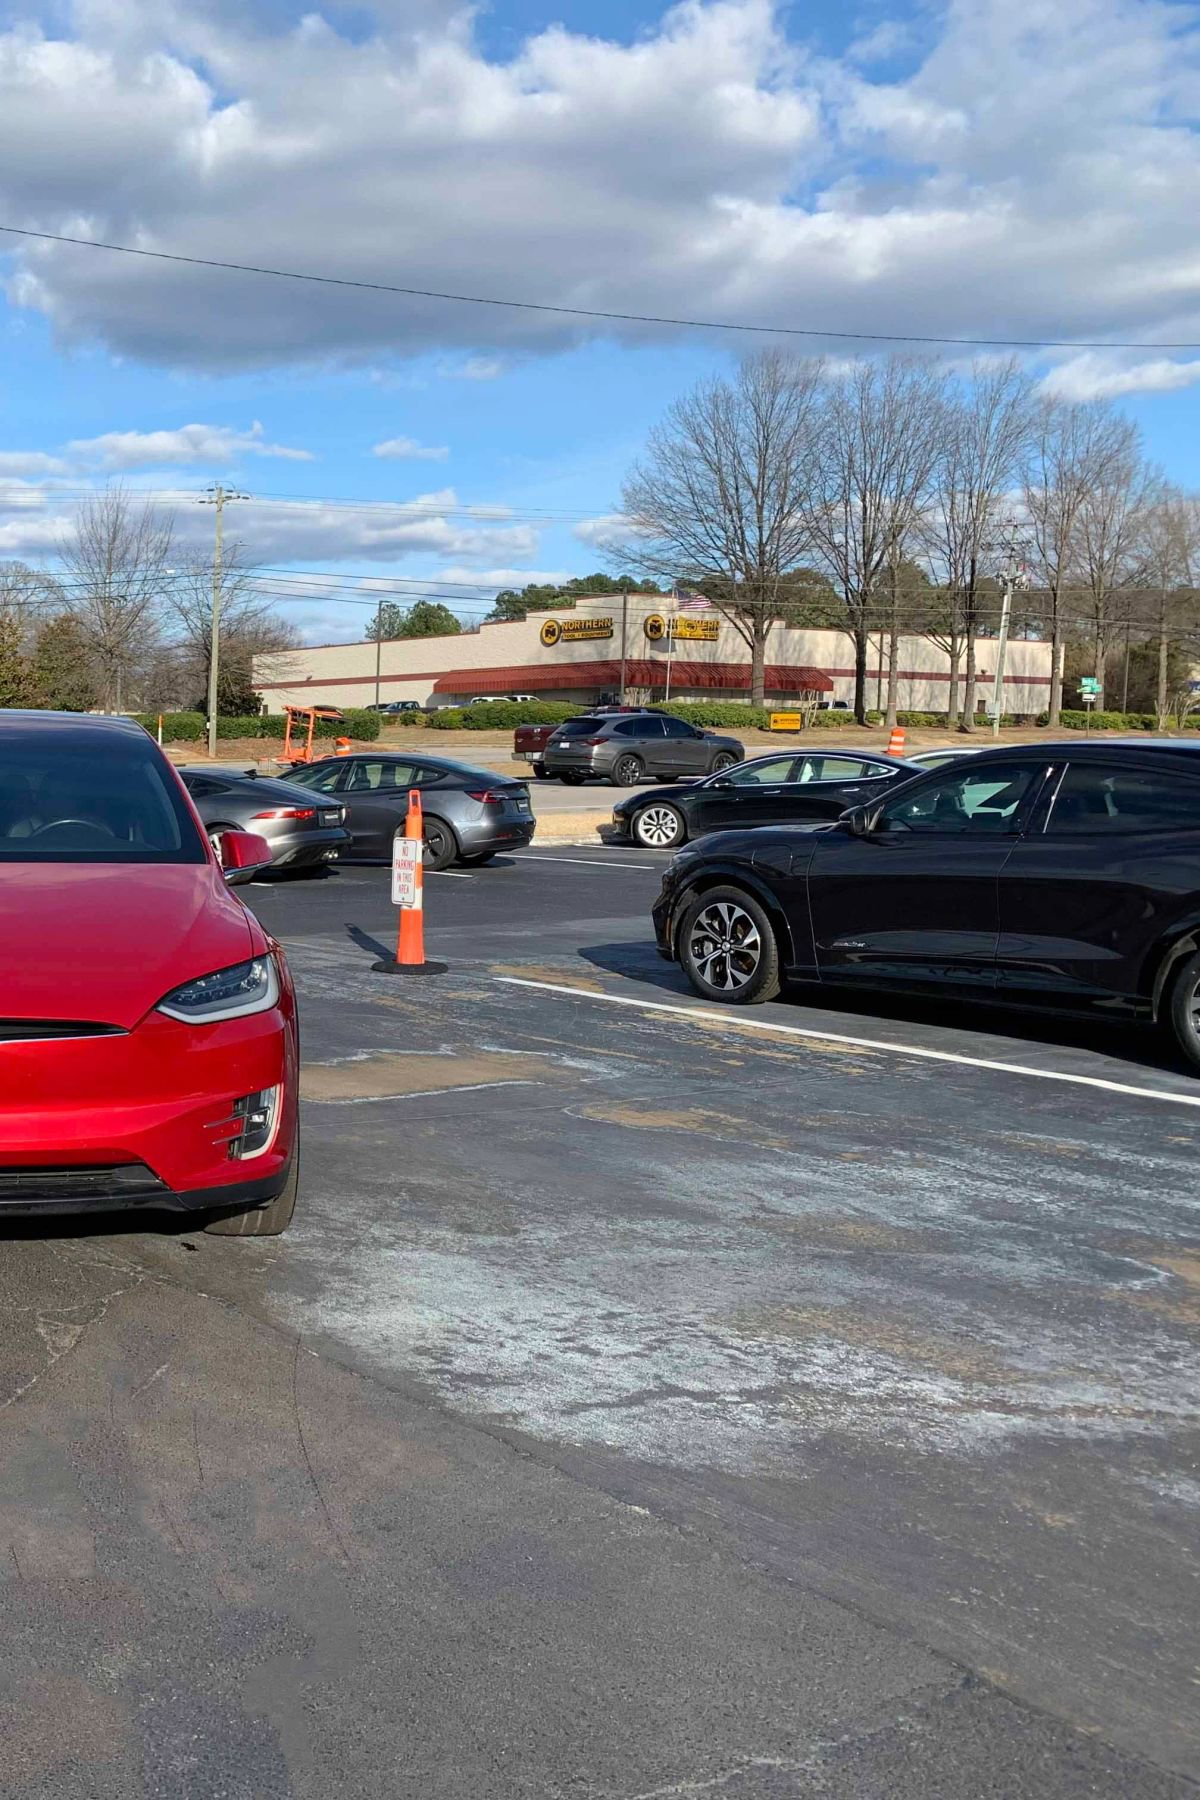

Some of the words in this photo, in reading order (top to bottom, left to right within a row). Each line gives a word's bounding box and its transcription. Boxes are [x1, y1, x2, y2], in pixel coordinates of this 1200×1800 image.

[562, 617, 613, 631] NORTHERN
[402, 846, 408, 856] NO
[396, 858, 414, 870] PARKING
[402, 872, 412, 883] THIS
[399, 884, 409, 894] AREA
